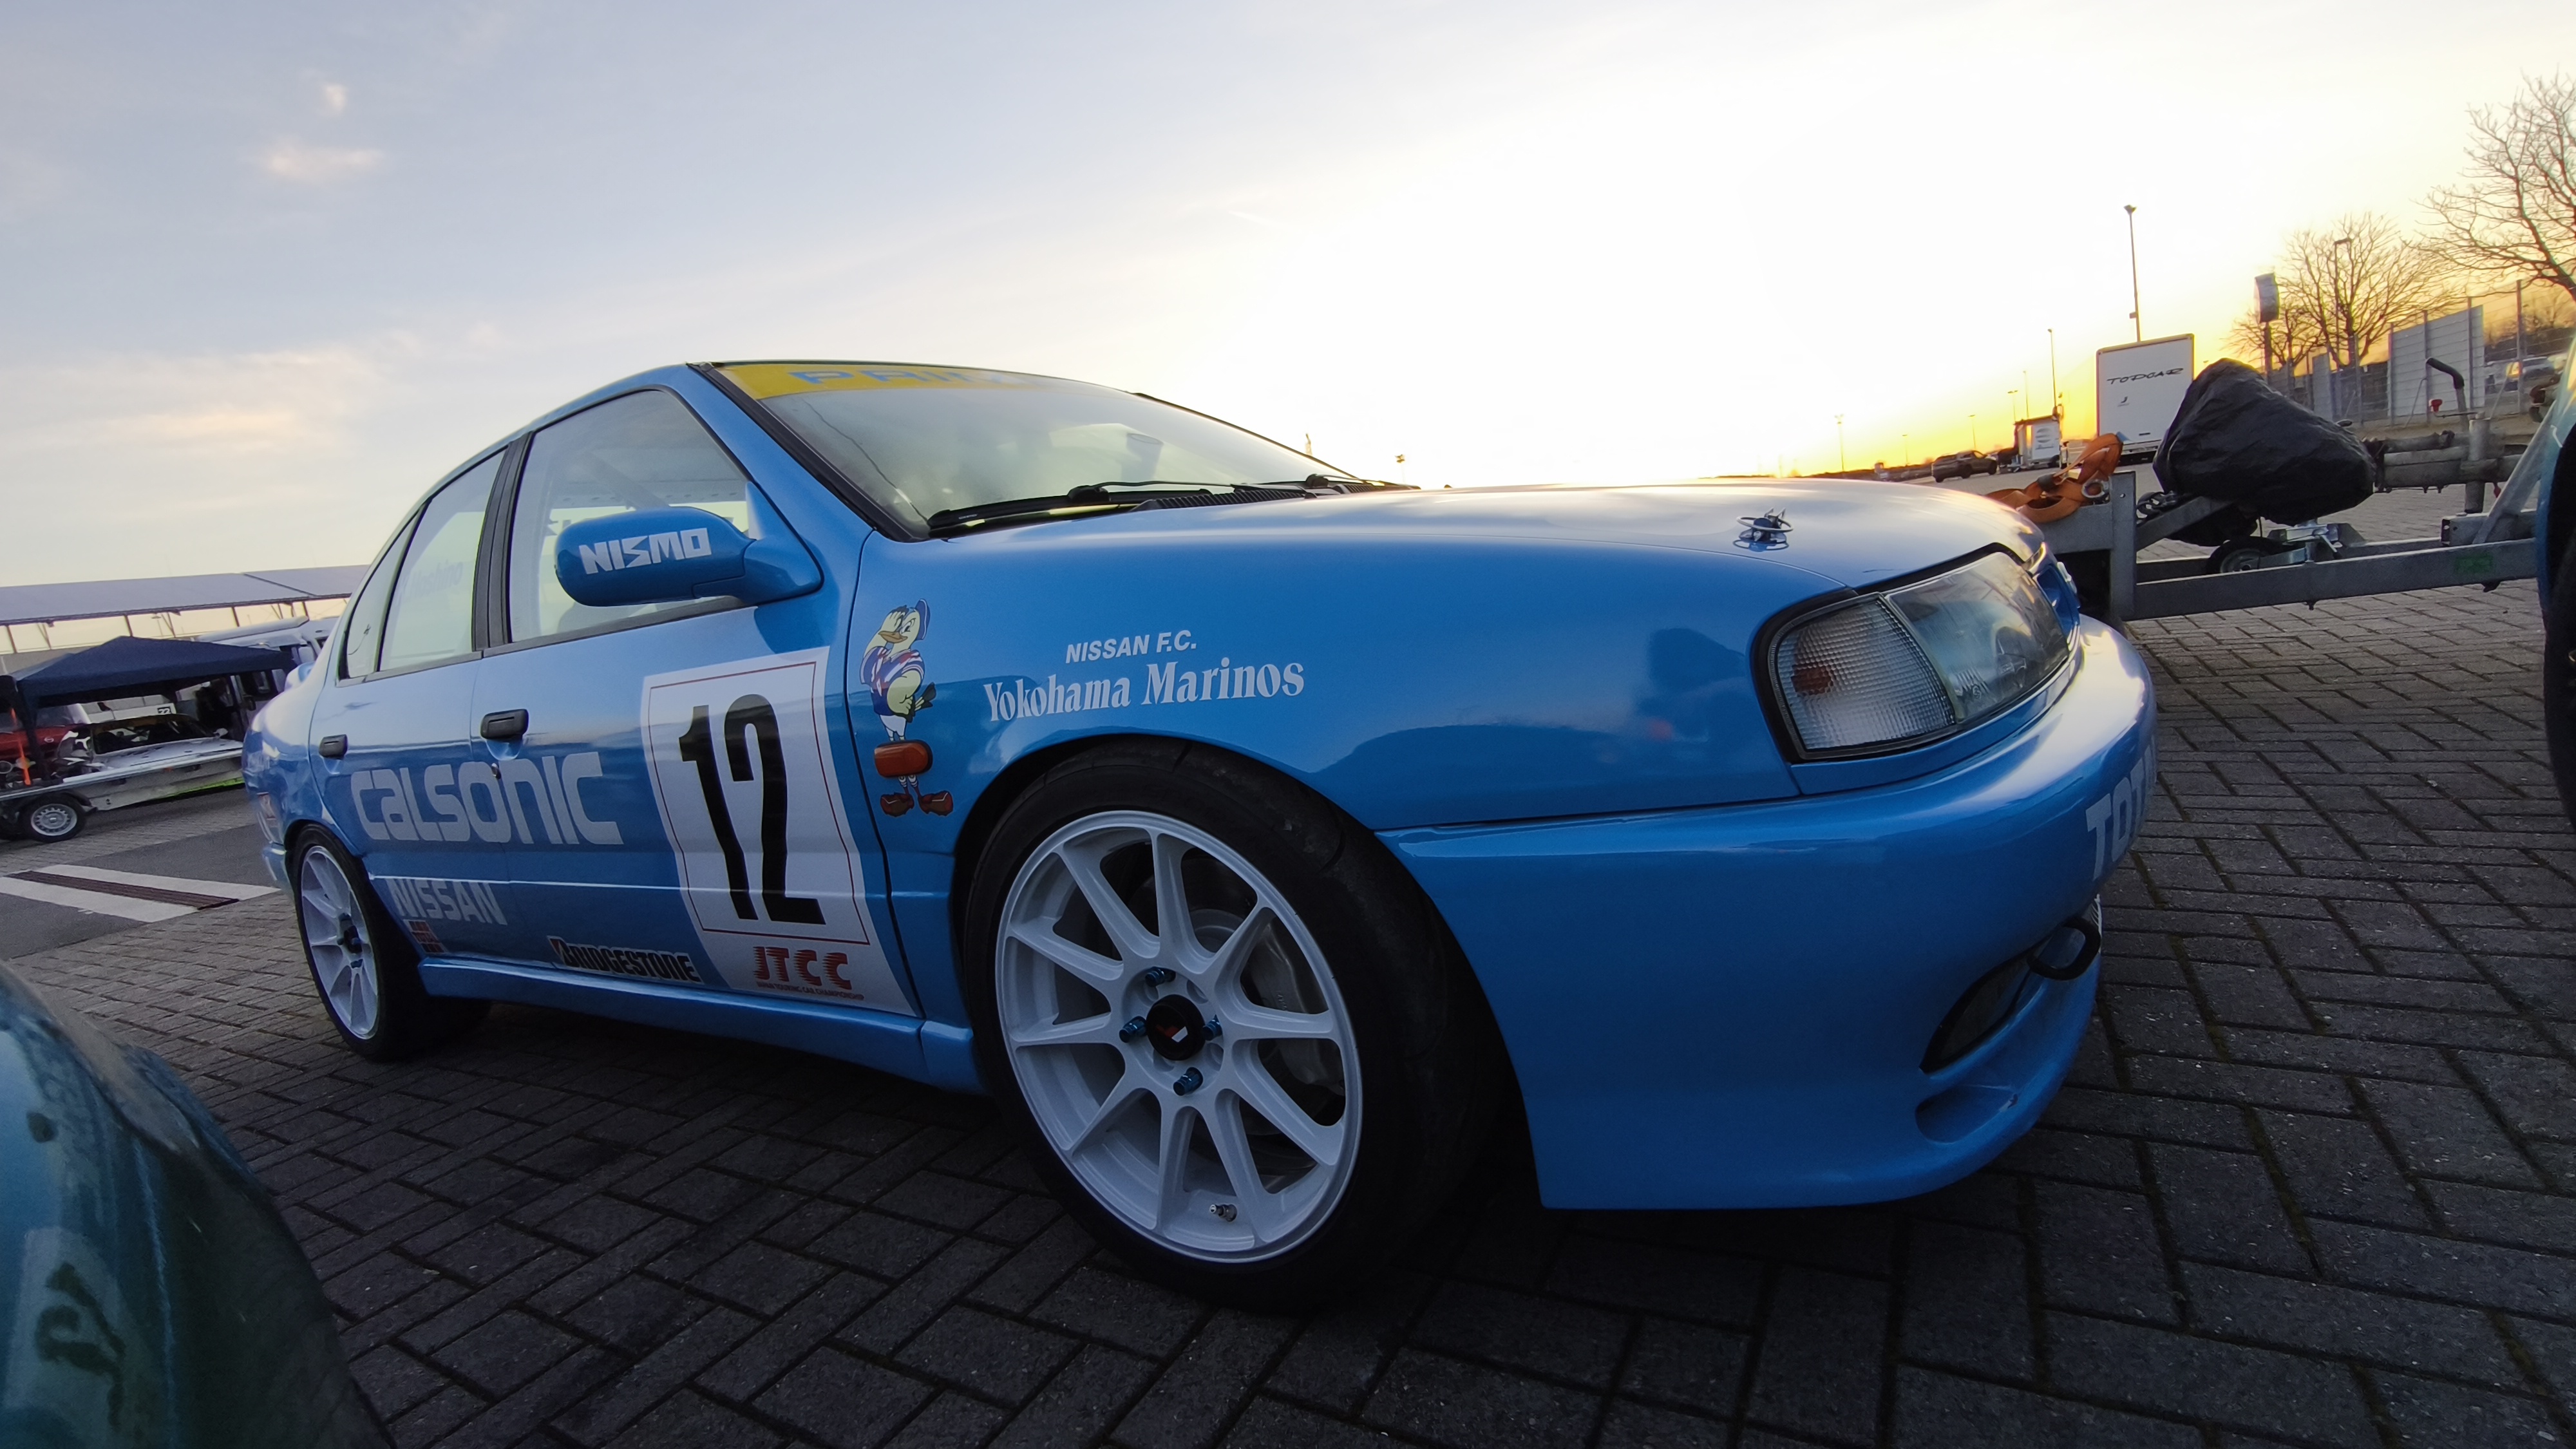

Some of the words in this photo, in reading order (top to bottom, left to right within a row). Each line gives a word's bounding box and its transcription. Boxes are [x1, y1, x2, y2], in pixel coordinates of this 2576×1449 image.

[579, 527, 712, 574] NISMO
[1065, 634, 1150, 664] NISSAN
[1156, 630, 1197, 653] F.C.
[983, 674, 1131, 722] Yokohama
[1141, 657, 1305, 706] Marinos
[679, 694, 826, 925] 12
[386, 878, 508, 925] NISSAN
[550, 938, 701, 982] BRIDGESTONE
[753, 946, 852, 990] JTCC
